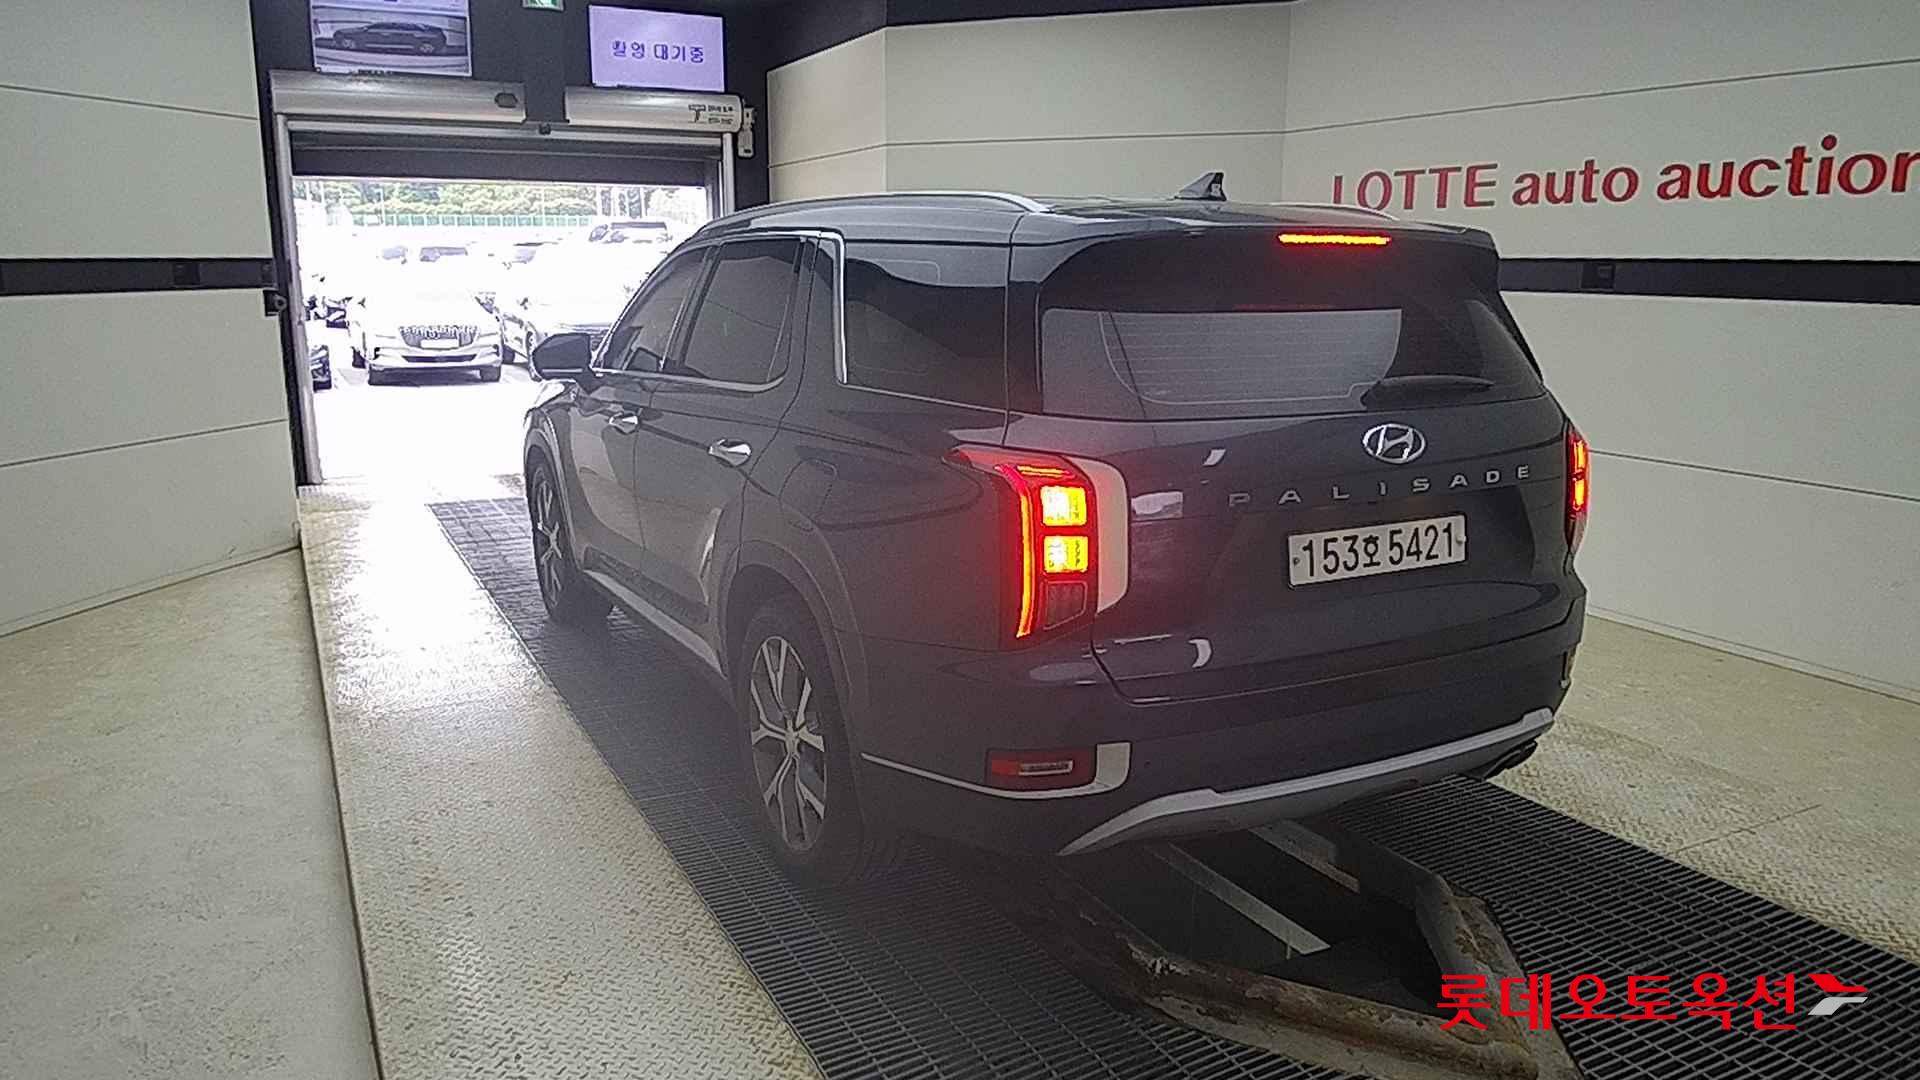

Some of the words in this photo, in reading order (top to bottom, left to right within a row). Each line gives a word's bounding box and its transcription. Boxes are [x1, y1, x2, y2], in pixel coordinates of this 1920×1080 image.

[654, 43, 704, 63] 대기중
[1512, 158, 1639, 206] auto
[1229, 465, 1531, 508] PALISADE
